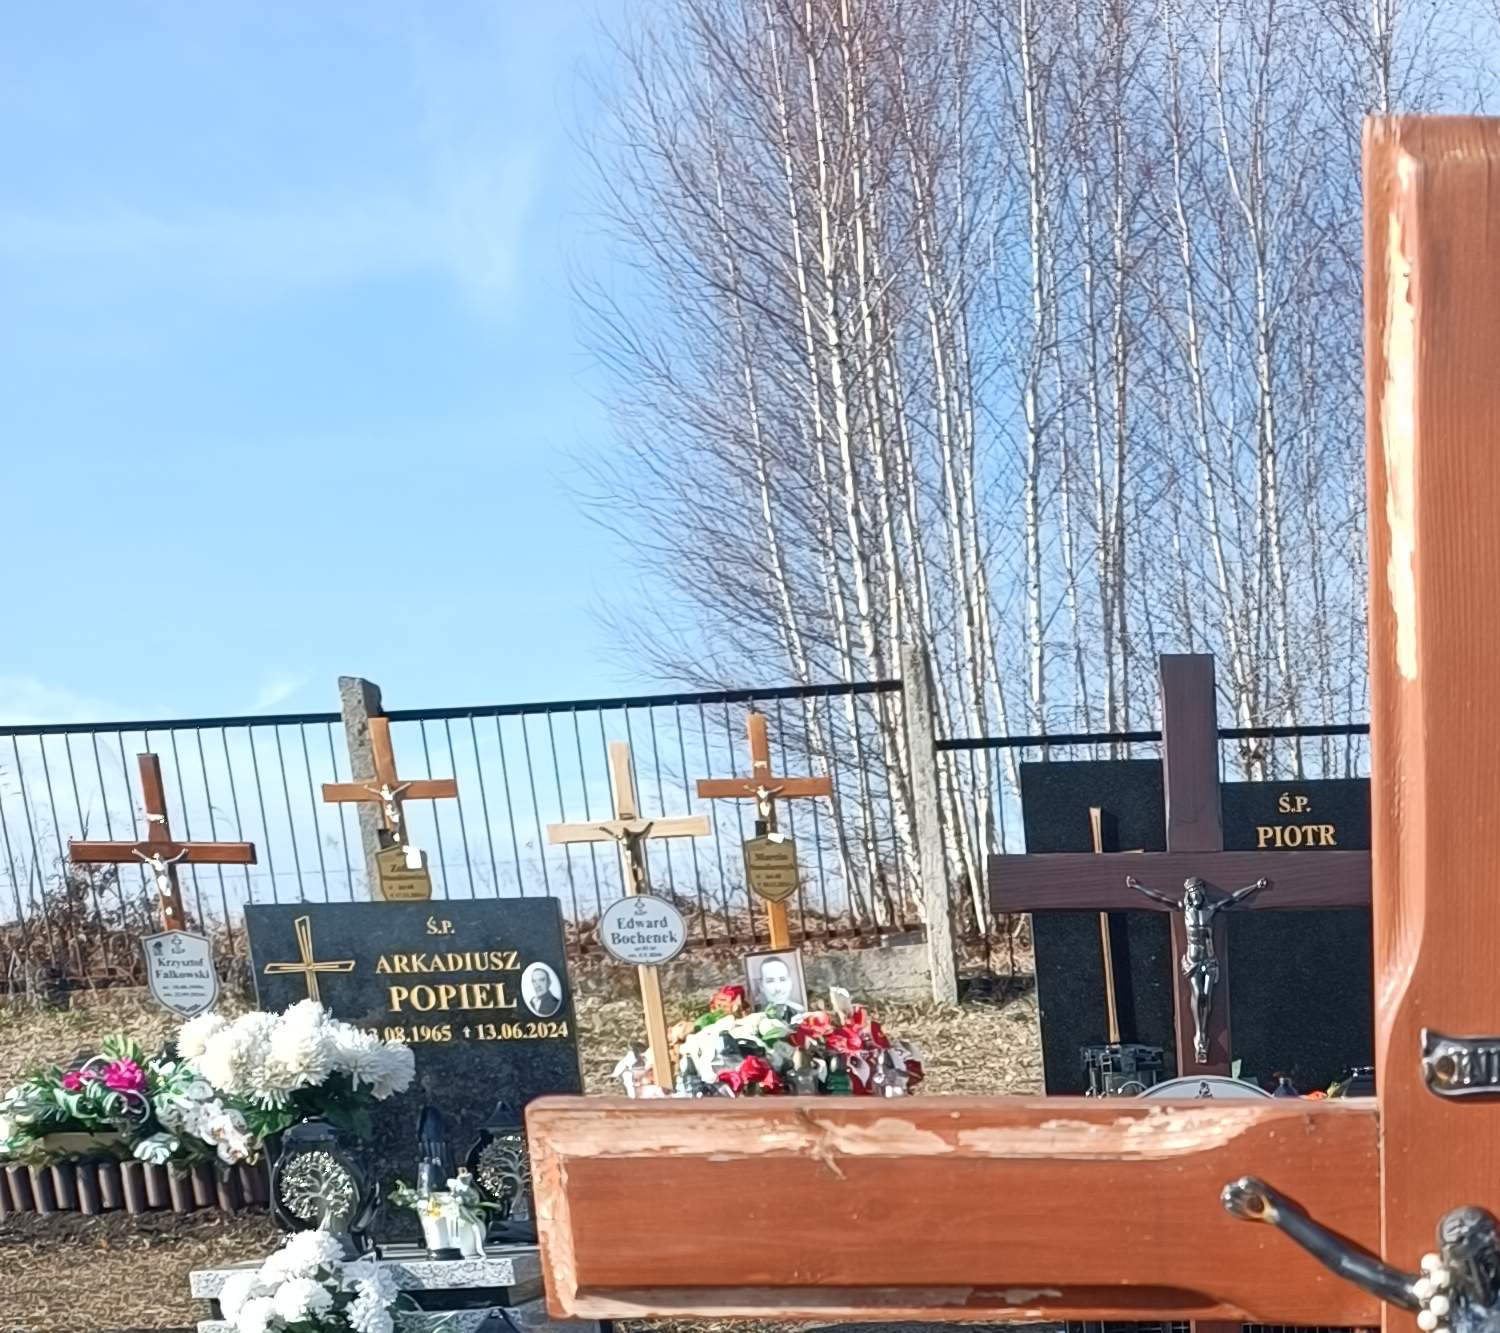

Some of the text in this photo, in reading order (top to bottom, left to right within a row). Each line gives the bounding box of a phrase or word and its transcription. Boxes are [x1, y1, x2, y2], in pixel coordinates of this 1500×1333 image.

[1278, 791, 1312, 813] Ś.P.
[1256, 823, 1337, 848] PIOTR
[616, 916, 668, 930] Edward
[611, 930, 678, 945] Bochenek
[375, 950, 521, 974] ARKADIUSZ
[389, 982, 518, 1012] POPIEL
[474, 1021, 569, 1041] 13.06.2024
